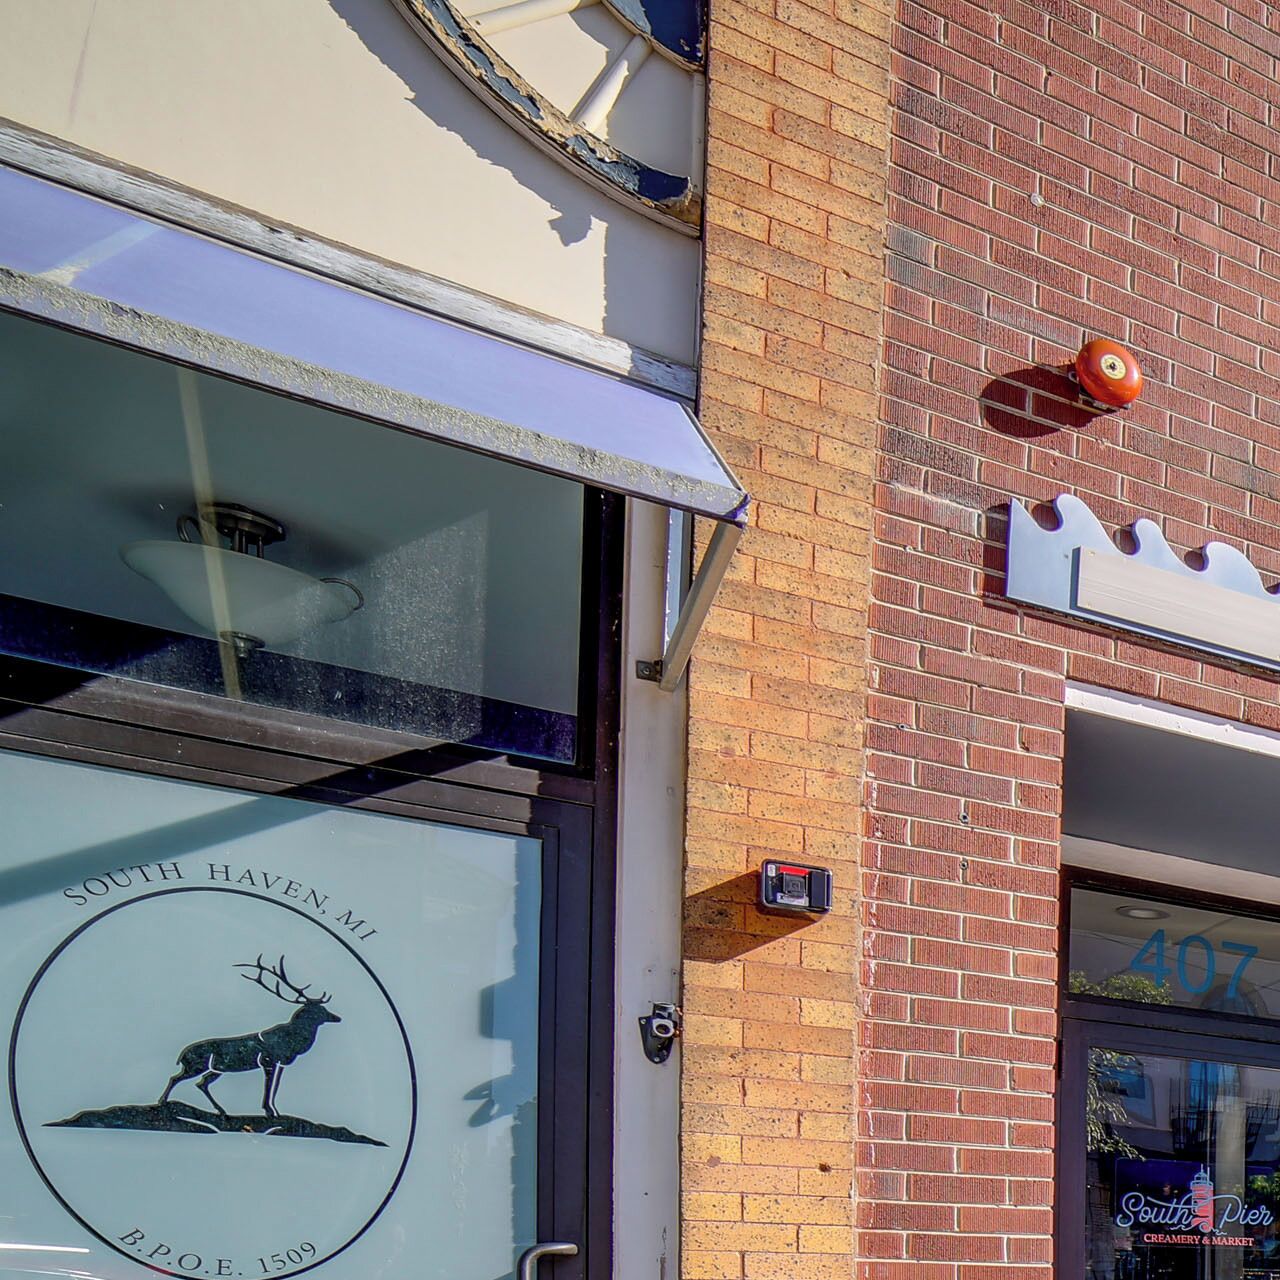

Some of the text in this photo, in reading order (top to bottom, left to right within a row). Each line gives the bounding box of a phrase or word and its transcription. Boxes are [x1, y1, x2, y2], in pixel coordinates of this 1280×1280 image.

[63, 861, 380, 943] SOUTH HAVEN, MI
[1130, 928, 1259, 998] 407
[1116, 1191, 1274, 1229] South Pier
[118, 1227, 318, 1277] B.P.O.E. 1509
[1143, 1233, 1255, 1247] CREAMERY & MARKET
